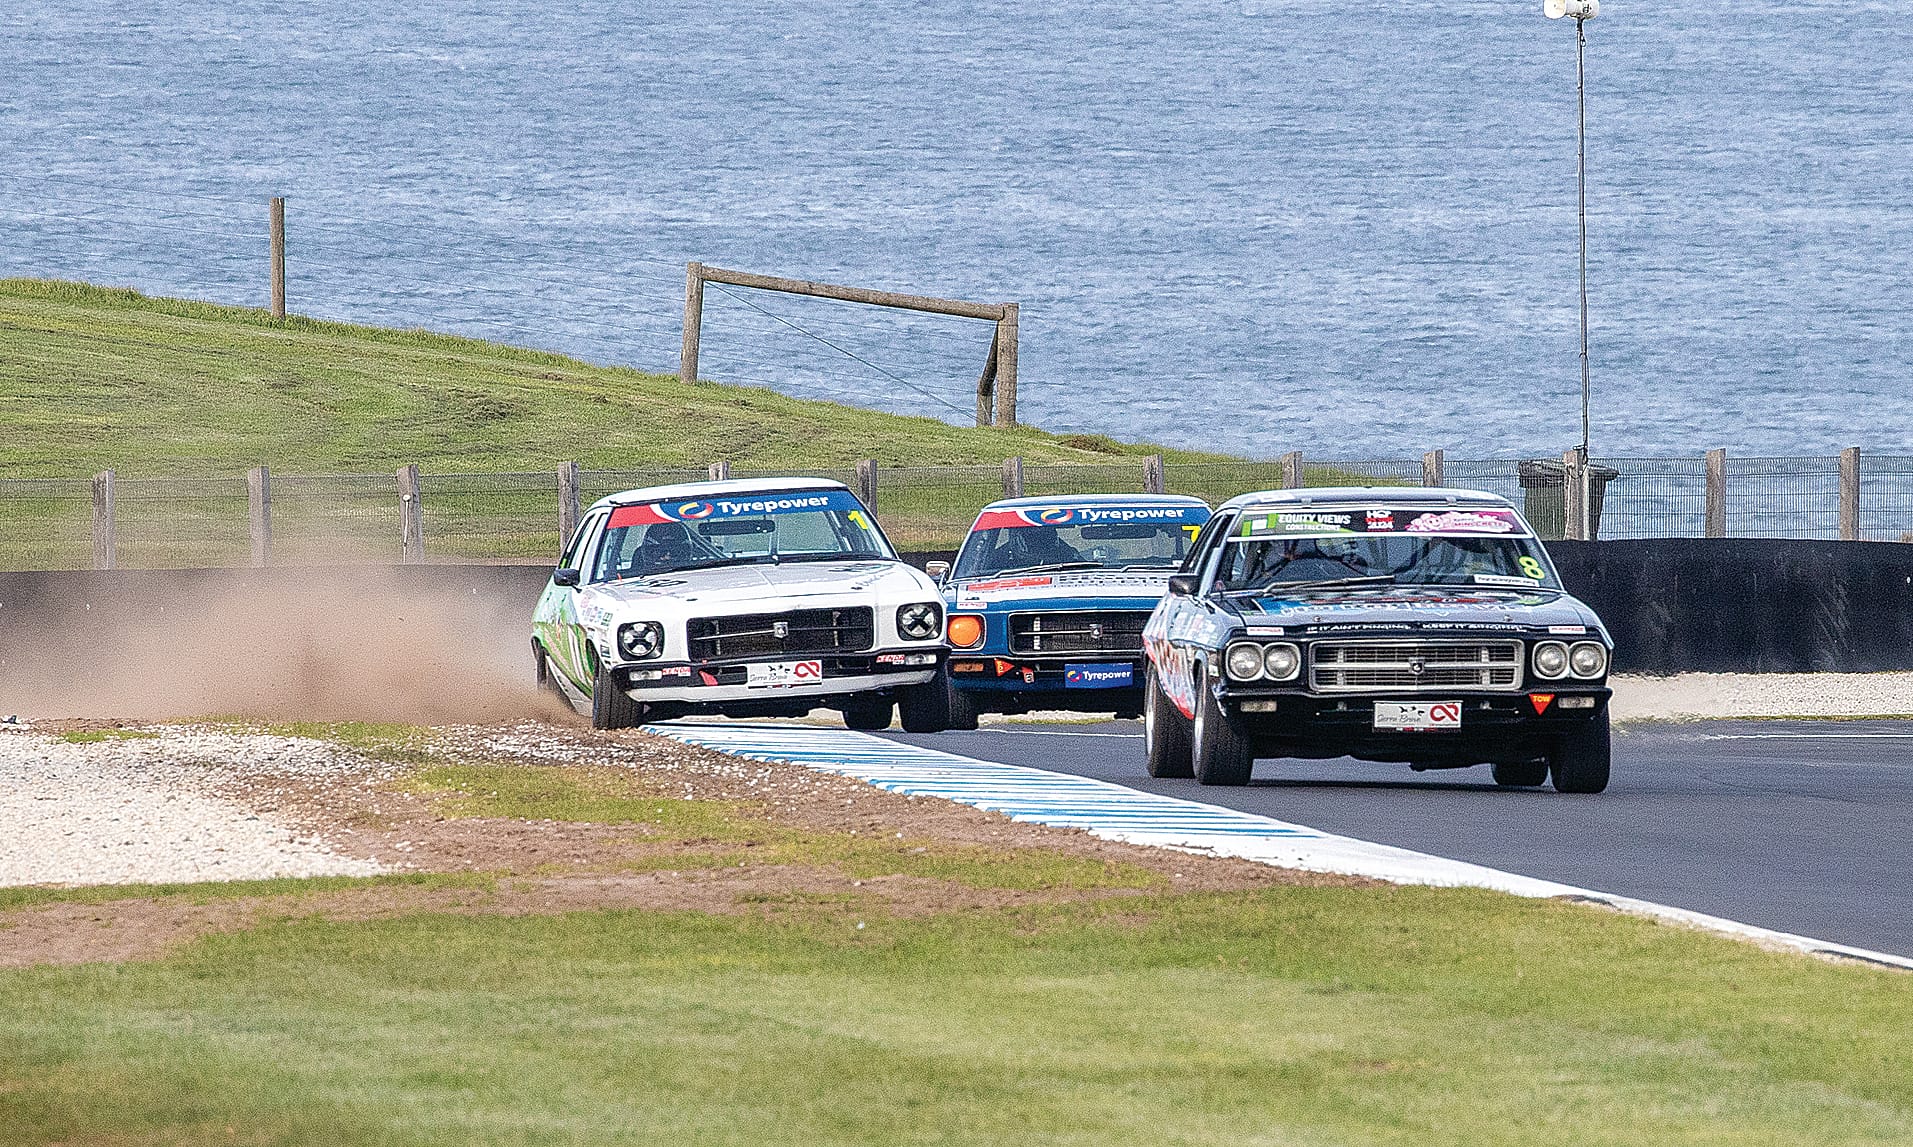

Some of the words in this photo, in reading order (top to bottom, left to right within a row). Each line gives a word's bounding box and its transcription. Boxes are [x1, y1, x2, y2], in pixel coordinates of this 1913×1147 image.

[717, 496, 829, 515] Tyrepower
[848, 510, 869, 530] 1
[1078, 509, 1185, 521] Tyrepower
[1279, 513, 1317, 524] EQUITY
[1317, 514, 1352, 525] VIEWS
[1181, 525, 1201, 544] 7
[1518, 556, 1546, 579] 8
[1083, 670, 1131, 682] Tyrepower
[1533, 695, 1551, 703] TOW
